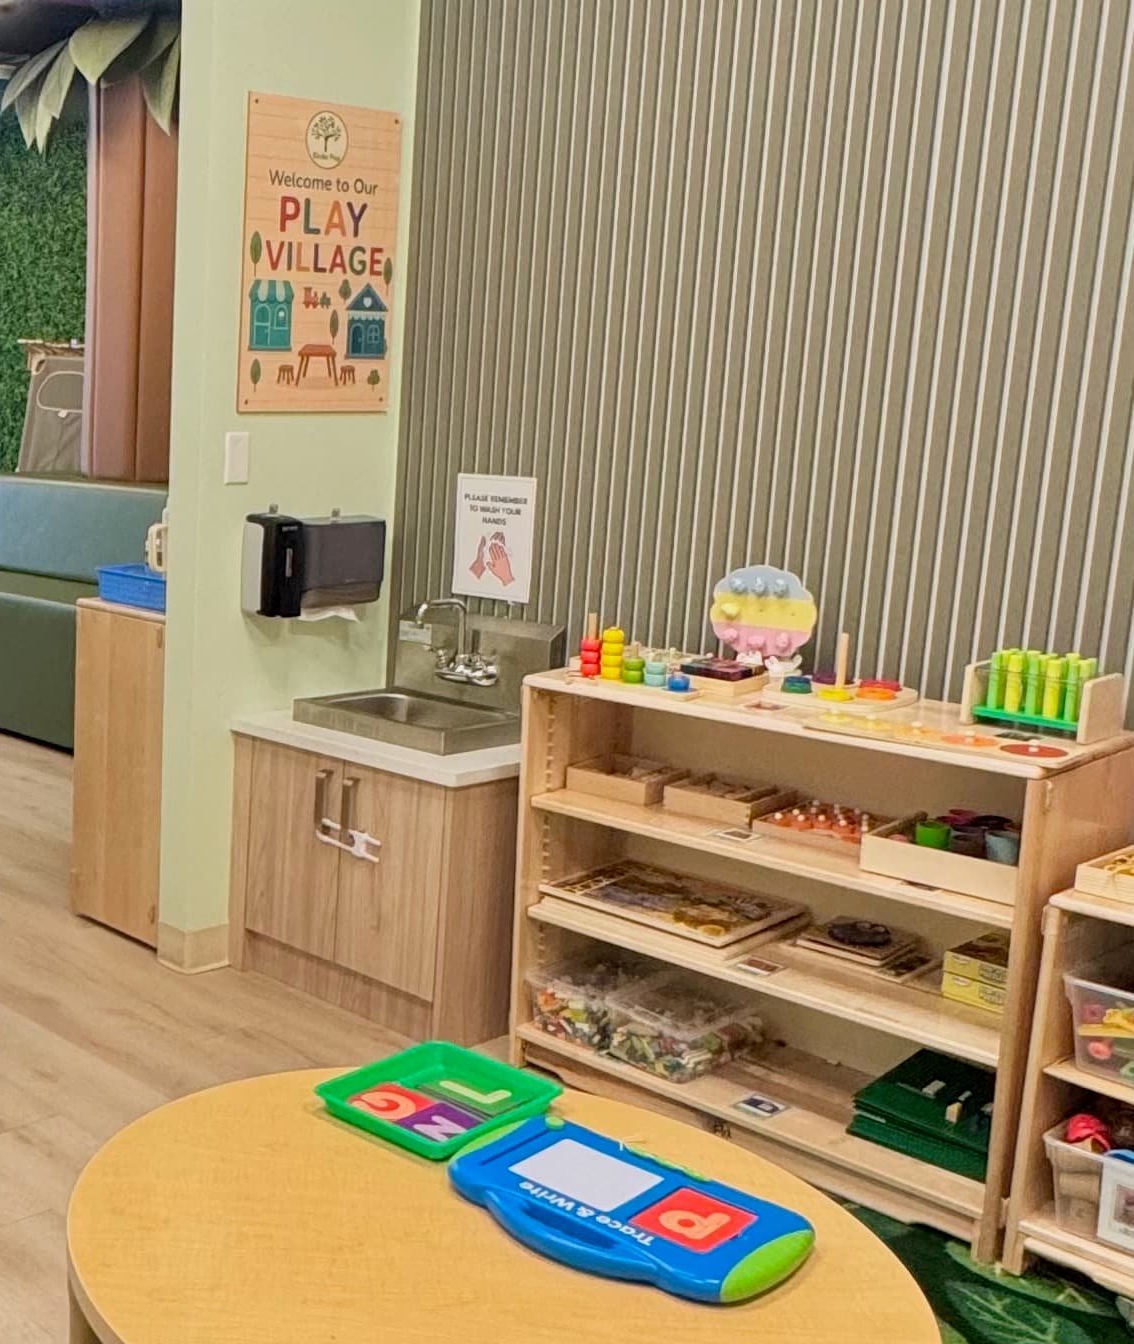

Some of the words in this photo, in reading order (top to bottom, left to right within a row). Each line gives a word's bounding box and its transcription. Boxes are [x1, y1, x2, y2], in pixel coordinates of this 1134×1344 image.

[269, 169, 333, 192] Welcome
[336, 175, 350, 193] to
[353, 178, 378, 196] Our
[279, 195, 368, 238] PLAY
[266, 239, 384, 277] VILLAGE
[464, 493, 489, 502] PLEASE
[490, 495, 528, 505] REMEMBER
[469, 504, 479, 512] TO
[480, 505, 500, 514] WASH
[501, 507, 522, 516] YOUR
[482, 517, 507, 526] HANDS
[518, 1181, 576, 1213] Write
[577, 1205, 596, 1219] &
[596, 1214, 656, 1246] Trace
